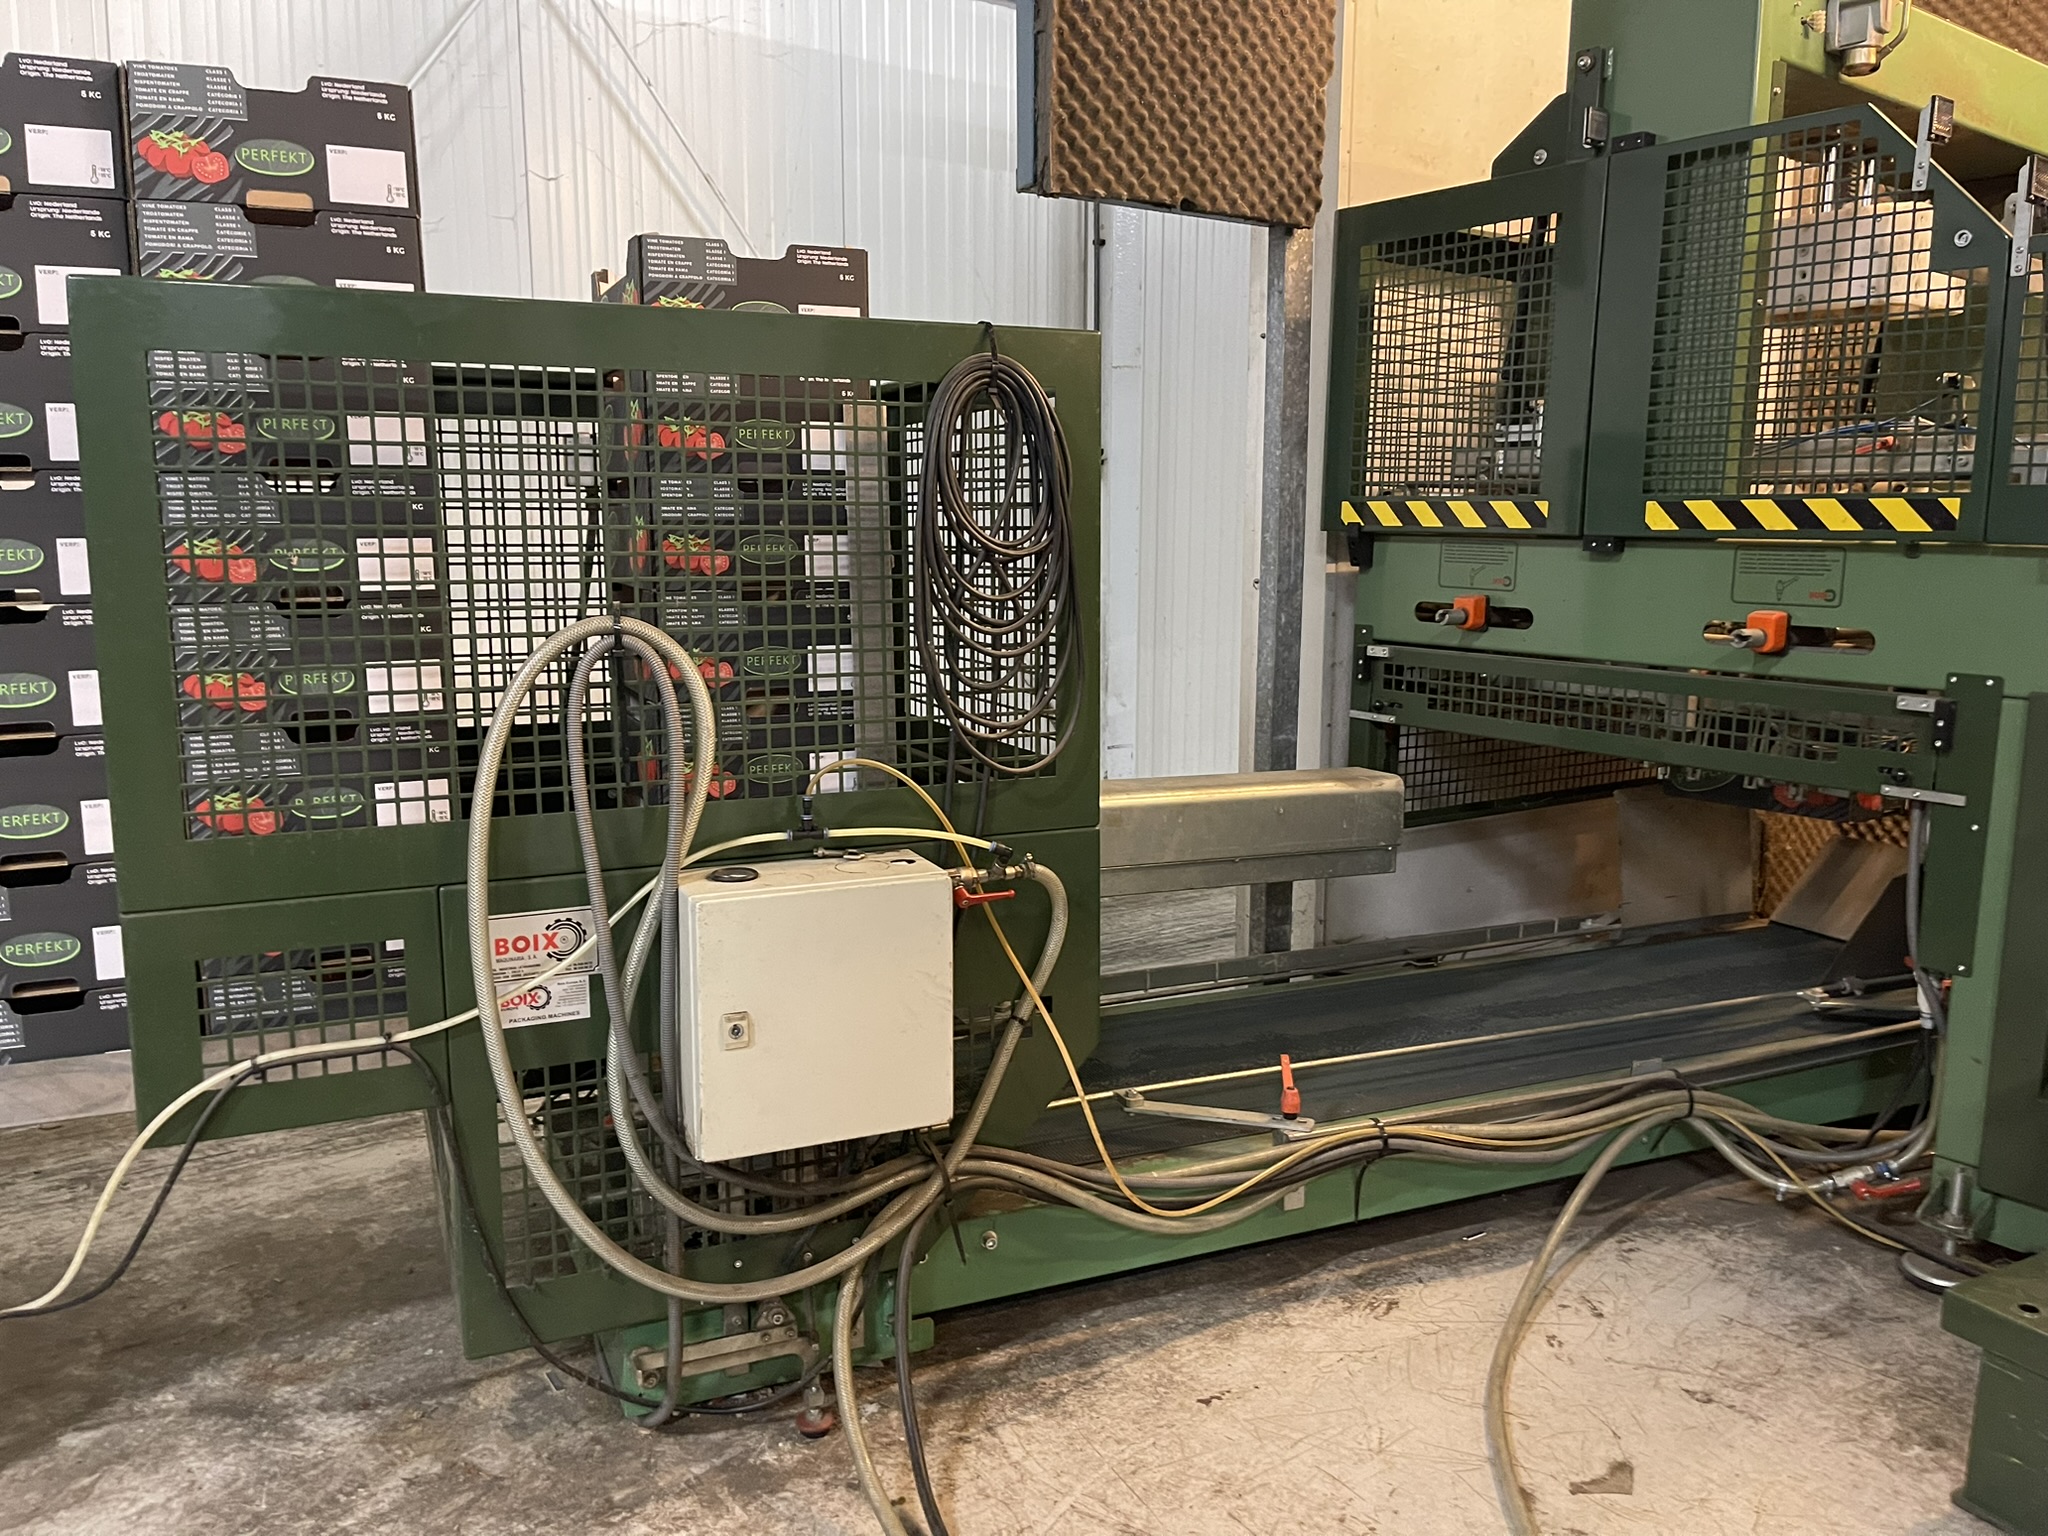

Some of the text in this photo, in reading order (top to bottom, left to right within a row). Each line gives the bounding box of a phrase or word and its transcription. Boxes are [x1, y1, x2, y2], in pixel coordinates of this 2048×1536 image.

[241, 147, 307, 164] PERFEKT
[263, 418, 327, 430] PRFEKT
[285, 672, 347, 685] PRFEKT
[0, 812, 59, 828] ERFEKT
[5, 939, 73, 957] PERFEKT
[494, 932, 560, 956] BOIX
[509, 1010, 580, 1023] PACKAGING MACHINES
